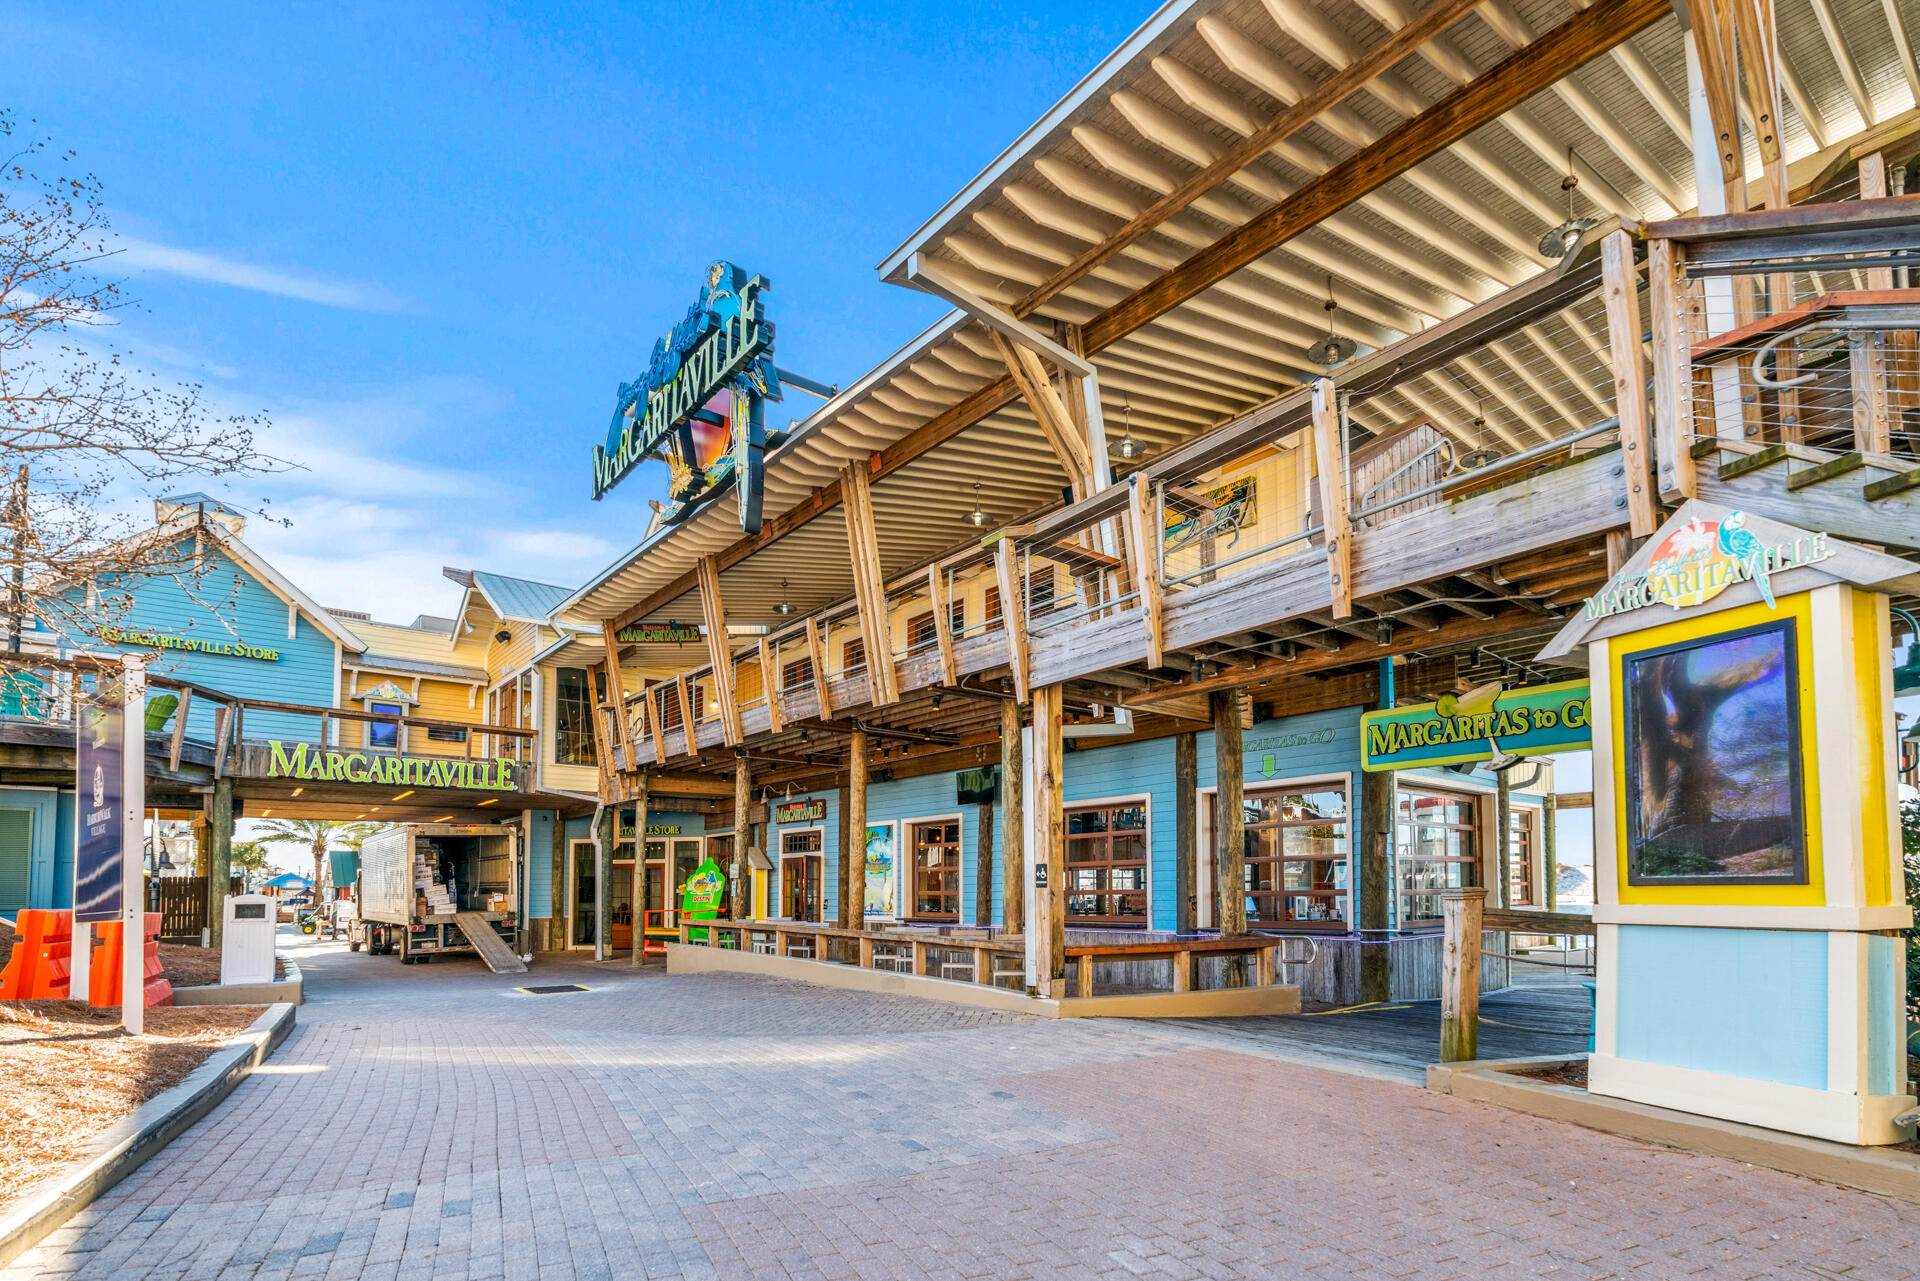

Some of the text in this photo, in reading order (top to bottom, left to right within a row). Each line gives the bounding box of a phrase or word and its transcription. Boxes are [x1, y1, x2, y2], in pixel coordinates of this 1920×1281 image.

[591, 273, 760, 500] MARGARITAVILLE
[1583, 532, 1830, 621] MARGARITAVILLE
[620, 626, 699, 641] MARGARITAVILLE
[233, 642, 280, 661] STORE
[1309, 727, 1336, 745] GO
[1368, 707, 1530, 756] MARGARITAS
[1532, 708, 1558, 729] to
[267, 740, 516, 790] MARGARITAVILLE
[654, 824, 680, 836] STORE
